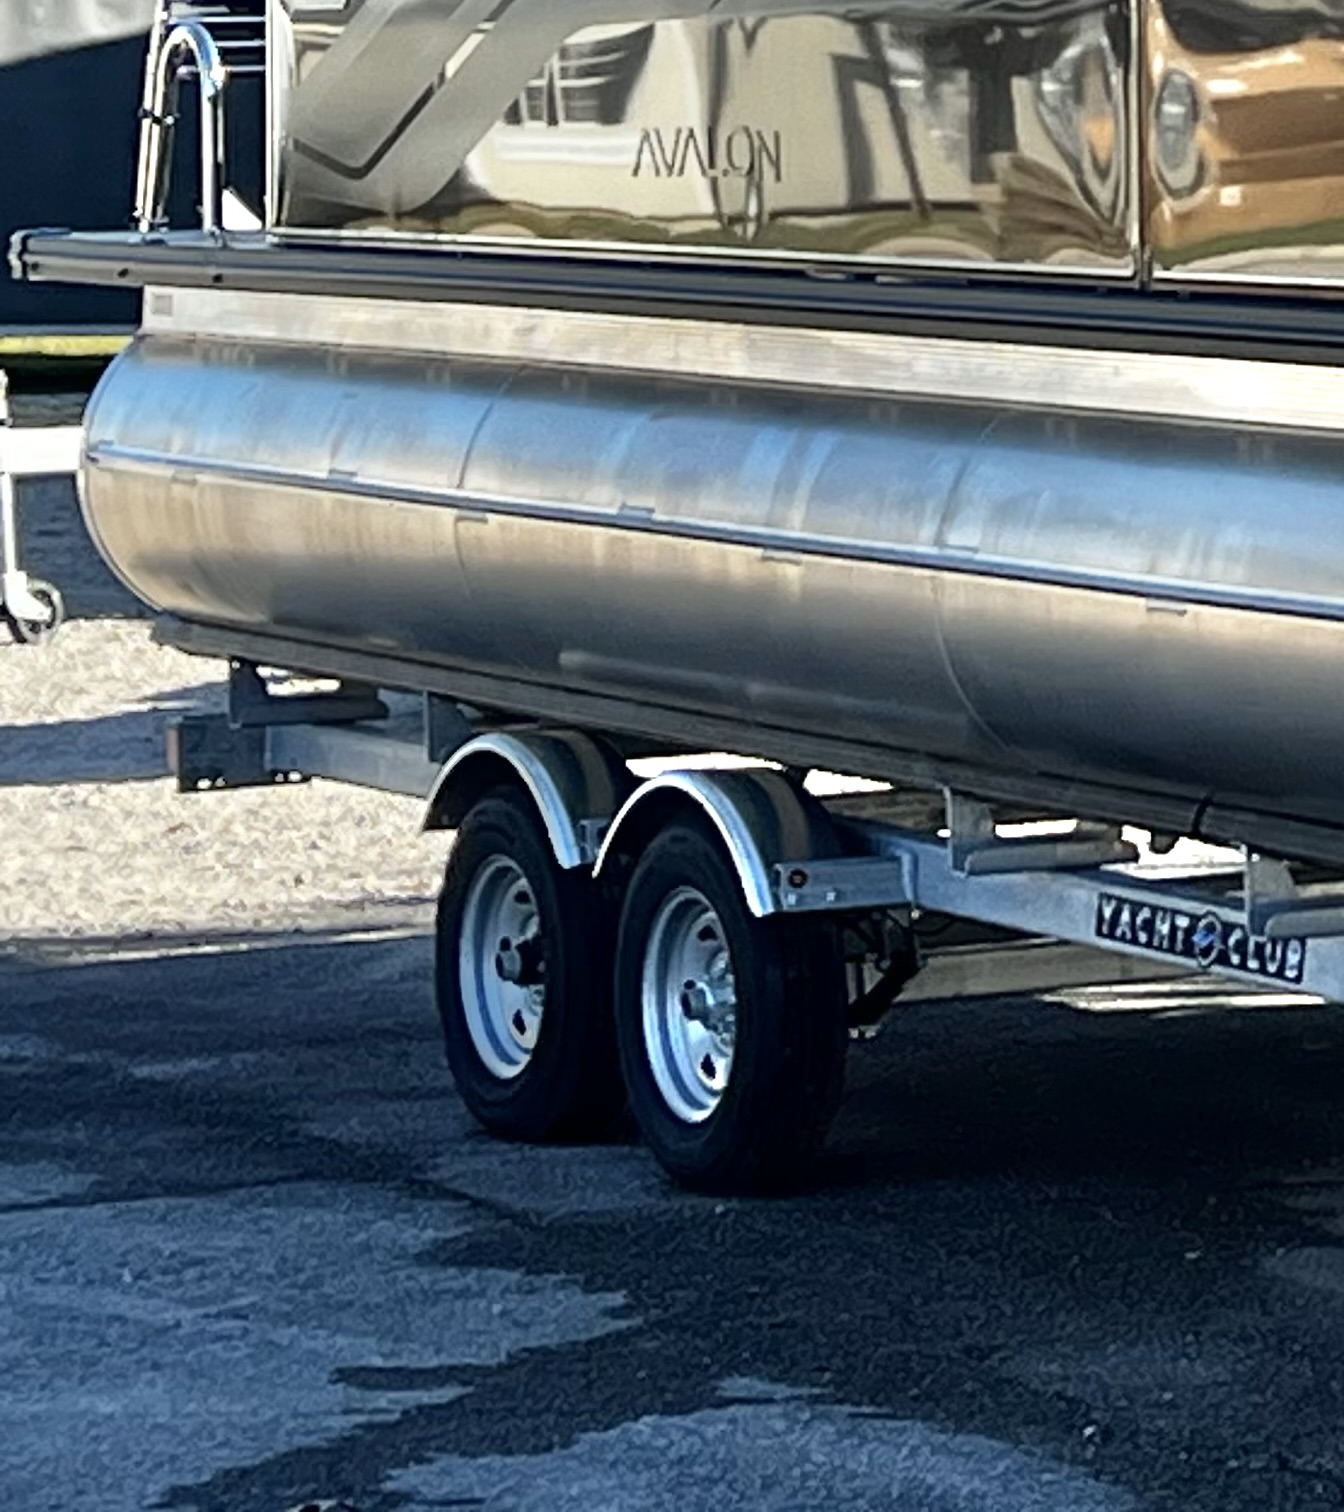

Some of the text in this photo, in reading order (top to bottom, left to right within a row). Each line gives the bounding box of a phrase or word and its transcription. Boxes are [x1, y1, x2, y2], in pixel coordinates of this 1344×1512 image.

[631, 124, 782, 183] AVALON
[1101, 898, 1302, 979] YACHT CLUB
